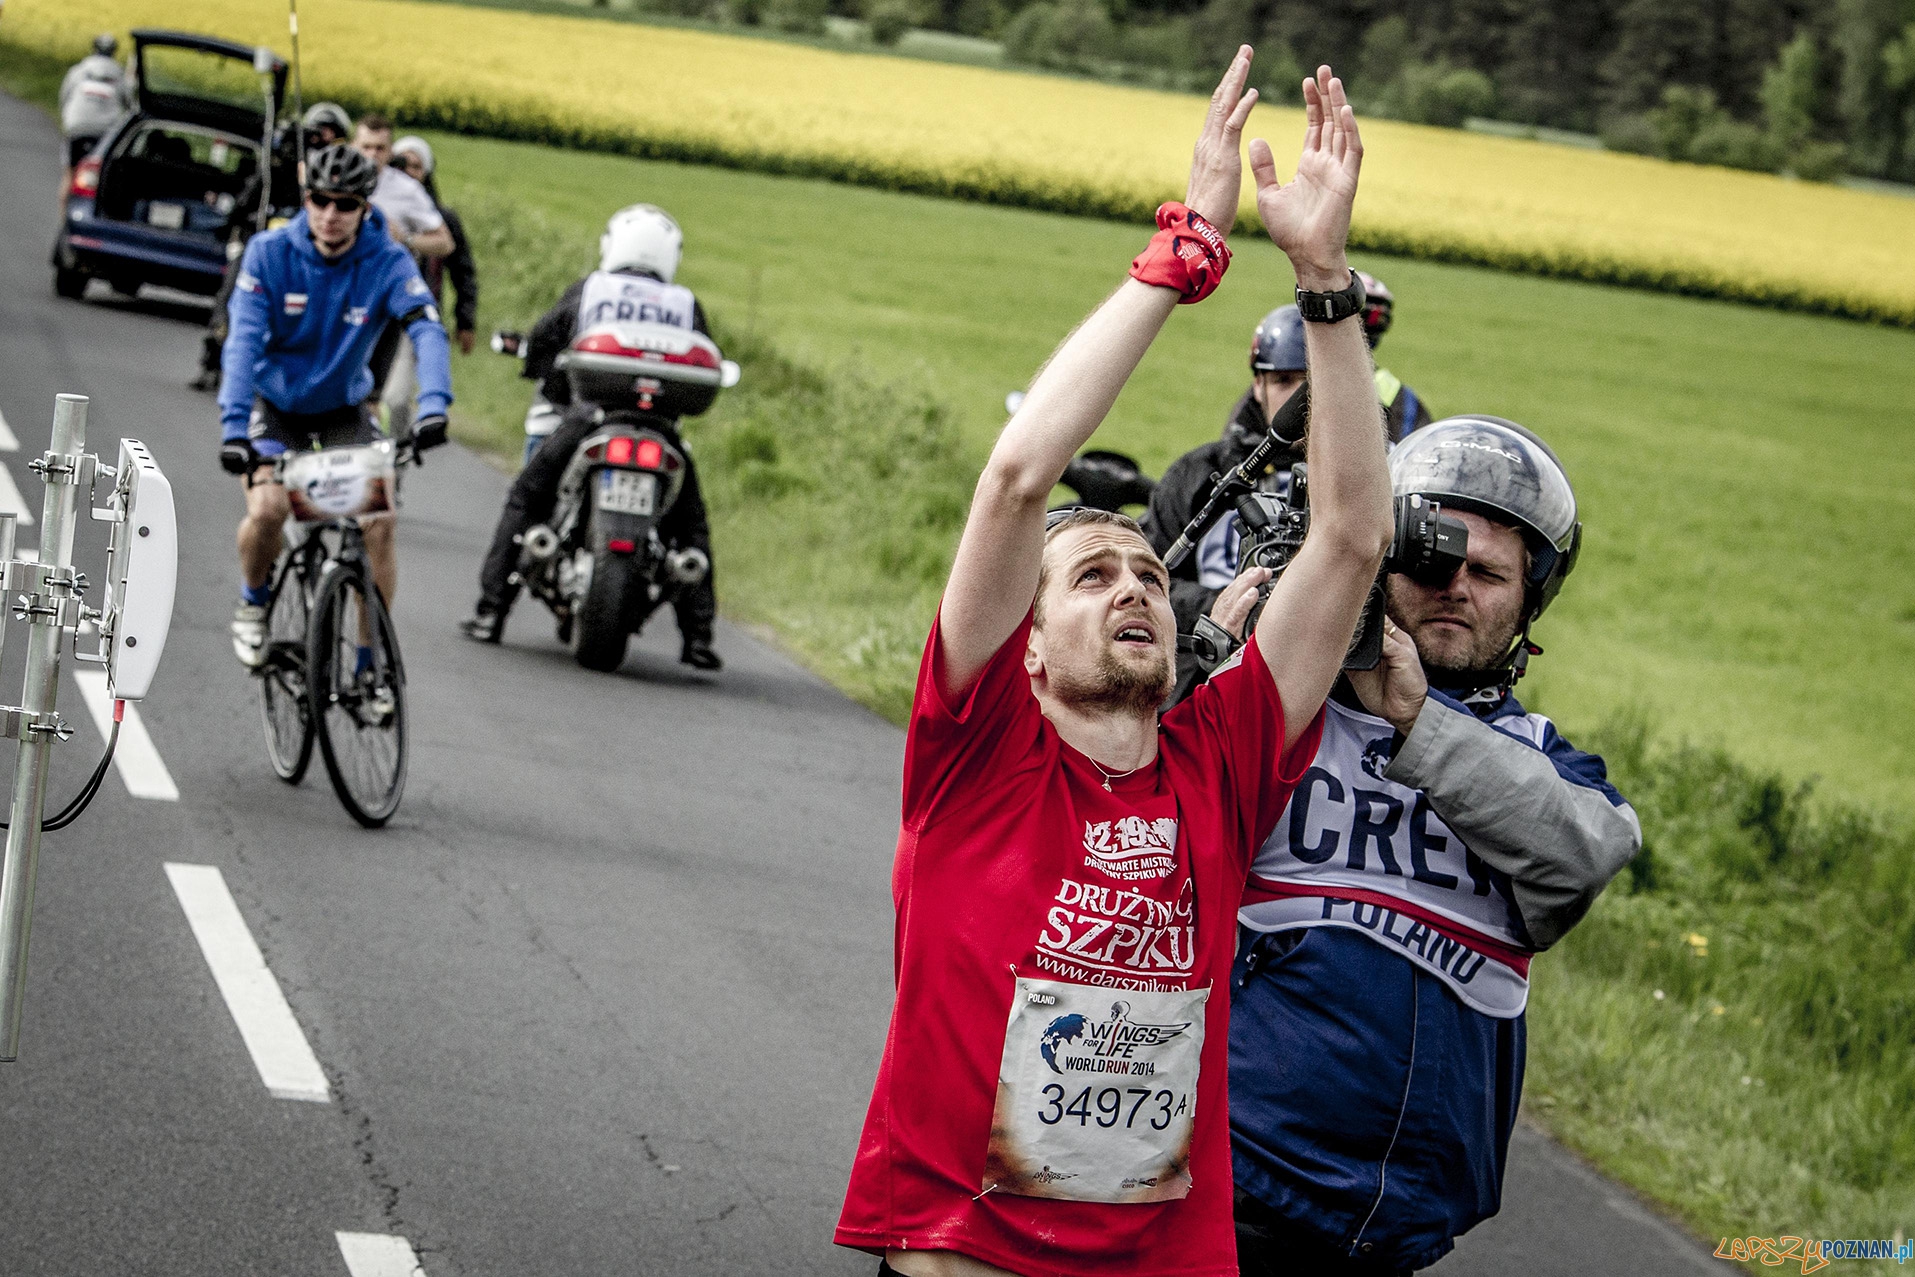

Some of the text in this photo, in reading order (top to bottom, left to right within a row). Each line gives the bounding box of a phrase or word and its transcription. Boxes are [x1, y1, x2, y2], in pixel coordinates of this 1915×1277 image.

[1441, 441, 1522, 464] G-MAC
[1437, 533, 1450, 541] ONY
[1123, 869, 1156, 880] SZPIKU
[1038, 906, 1195, 970] SZPIKU
[1322, 897, 1487, 985] POLAND
[1027, 993, 1056, 1005] POLAND
[1091, 1021, 1161, 1043] WINGS
[1083, 1039, 1139, 1058] FOR LIFE
[1131, 1061, 1155, 1076] 2014
[1037, 1083, 1174, 1131] 34973
